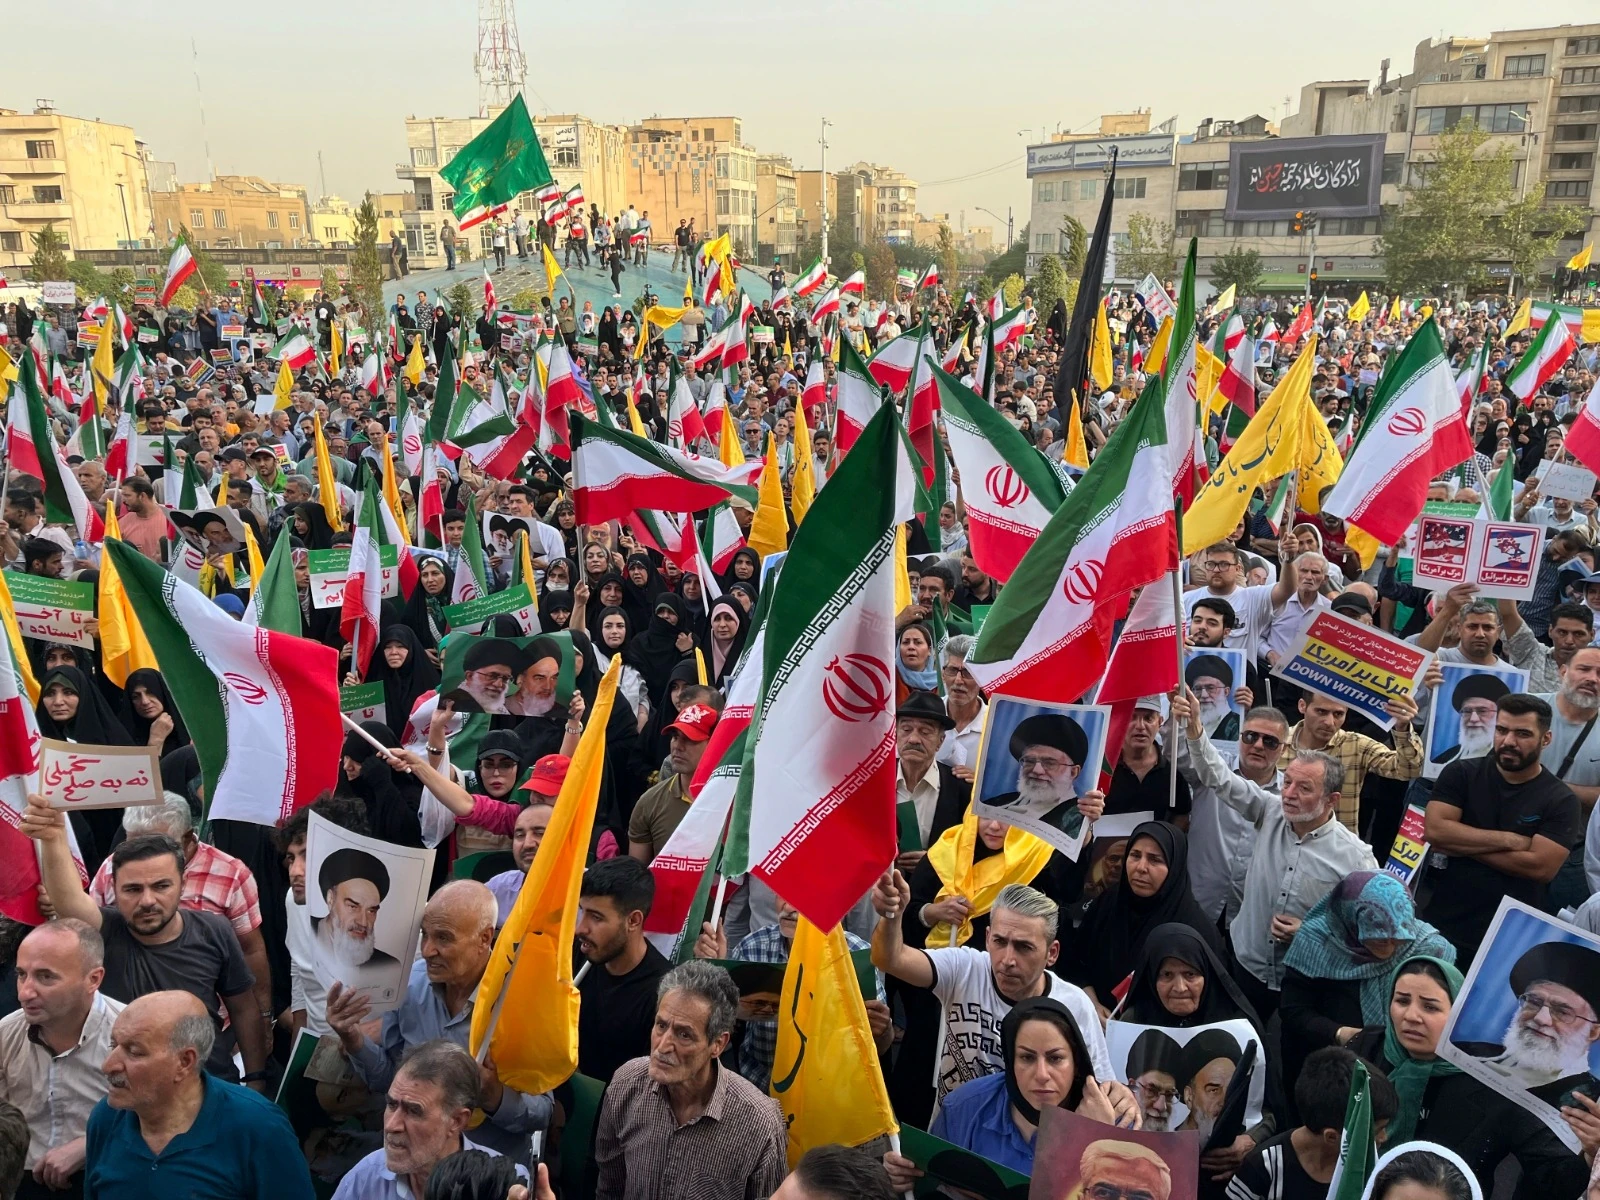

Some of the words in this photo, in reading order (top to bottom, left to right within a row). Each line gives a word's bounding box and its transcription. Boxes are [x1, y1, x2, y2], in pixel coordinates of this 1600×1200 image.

[1256, 163, 1284, 192] حسین
[382, 569, 391, 579] تا
[1420, 563, 1441, 574] آمریکا
[1447, 569, 1461, 578] مرگ
[1481, 572, 1507, 582] اسرائیل
[1512, 575, 1527, 584] مرگ
[70, 611, 83, 624] تا
[519, 609, 529, 619] تا
[29, 624, 83, 642] ایستاده
[1305, 642, 1359, 672] آمریکا
[1355, 668, 1372, 682] بر
[1289, 661, 1332, 686] DOWN
[1332, 680, 1368, 702] WITH
[1367, 695, 1386, 712] US
[362, 708, 374, 718] تا
[45, 755, 101, 795] تحمیلی
[126, 769, 149, 786] نه
[63, 775, 95, 802] صلح
[100, 778, 122, 793] به
[1393, 841, 1420, 862] مرگ
